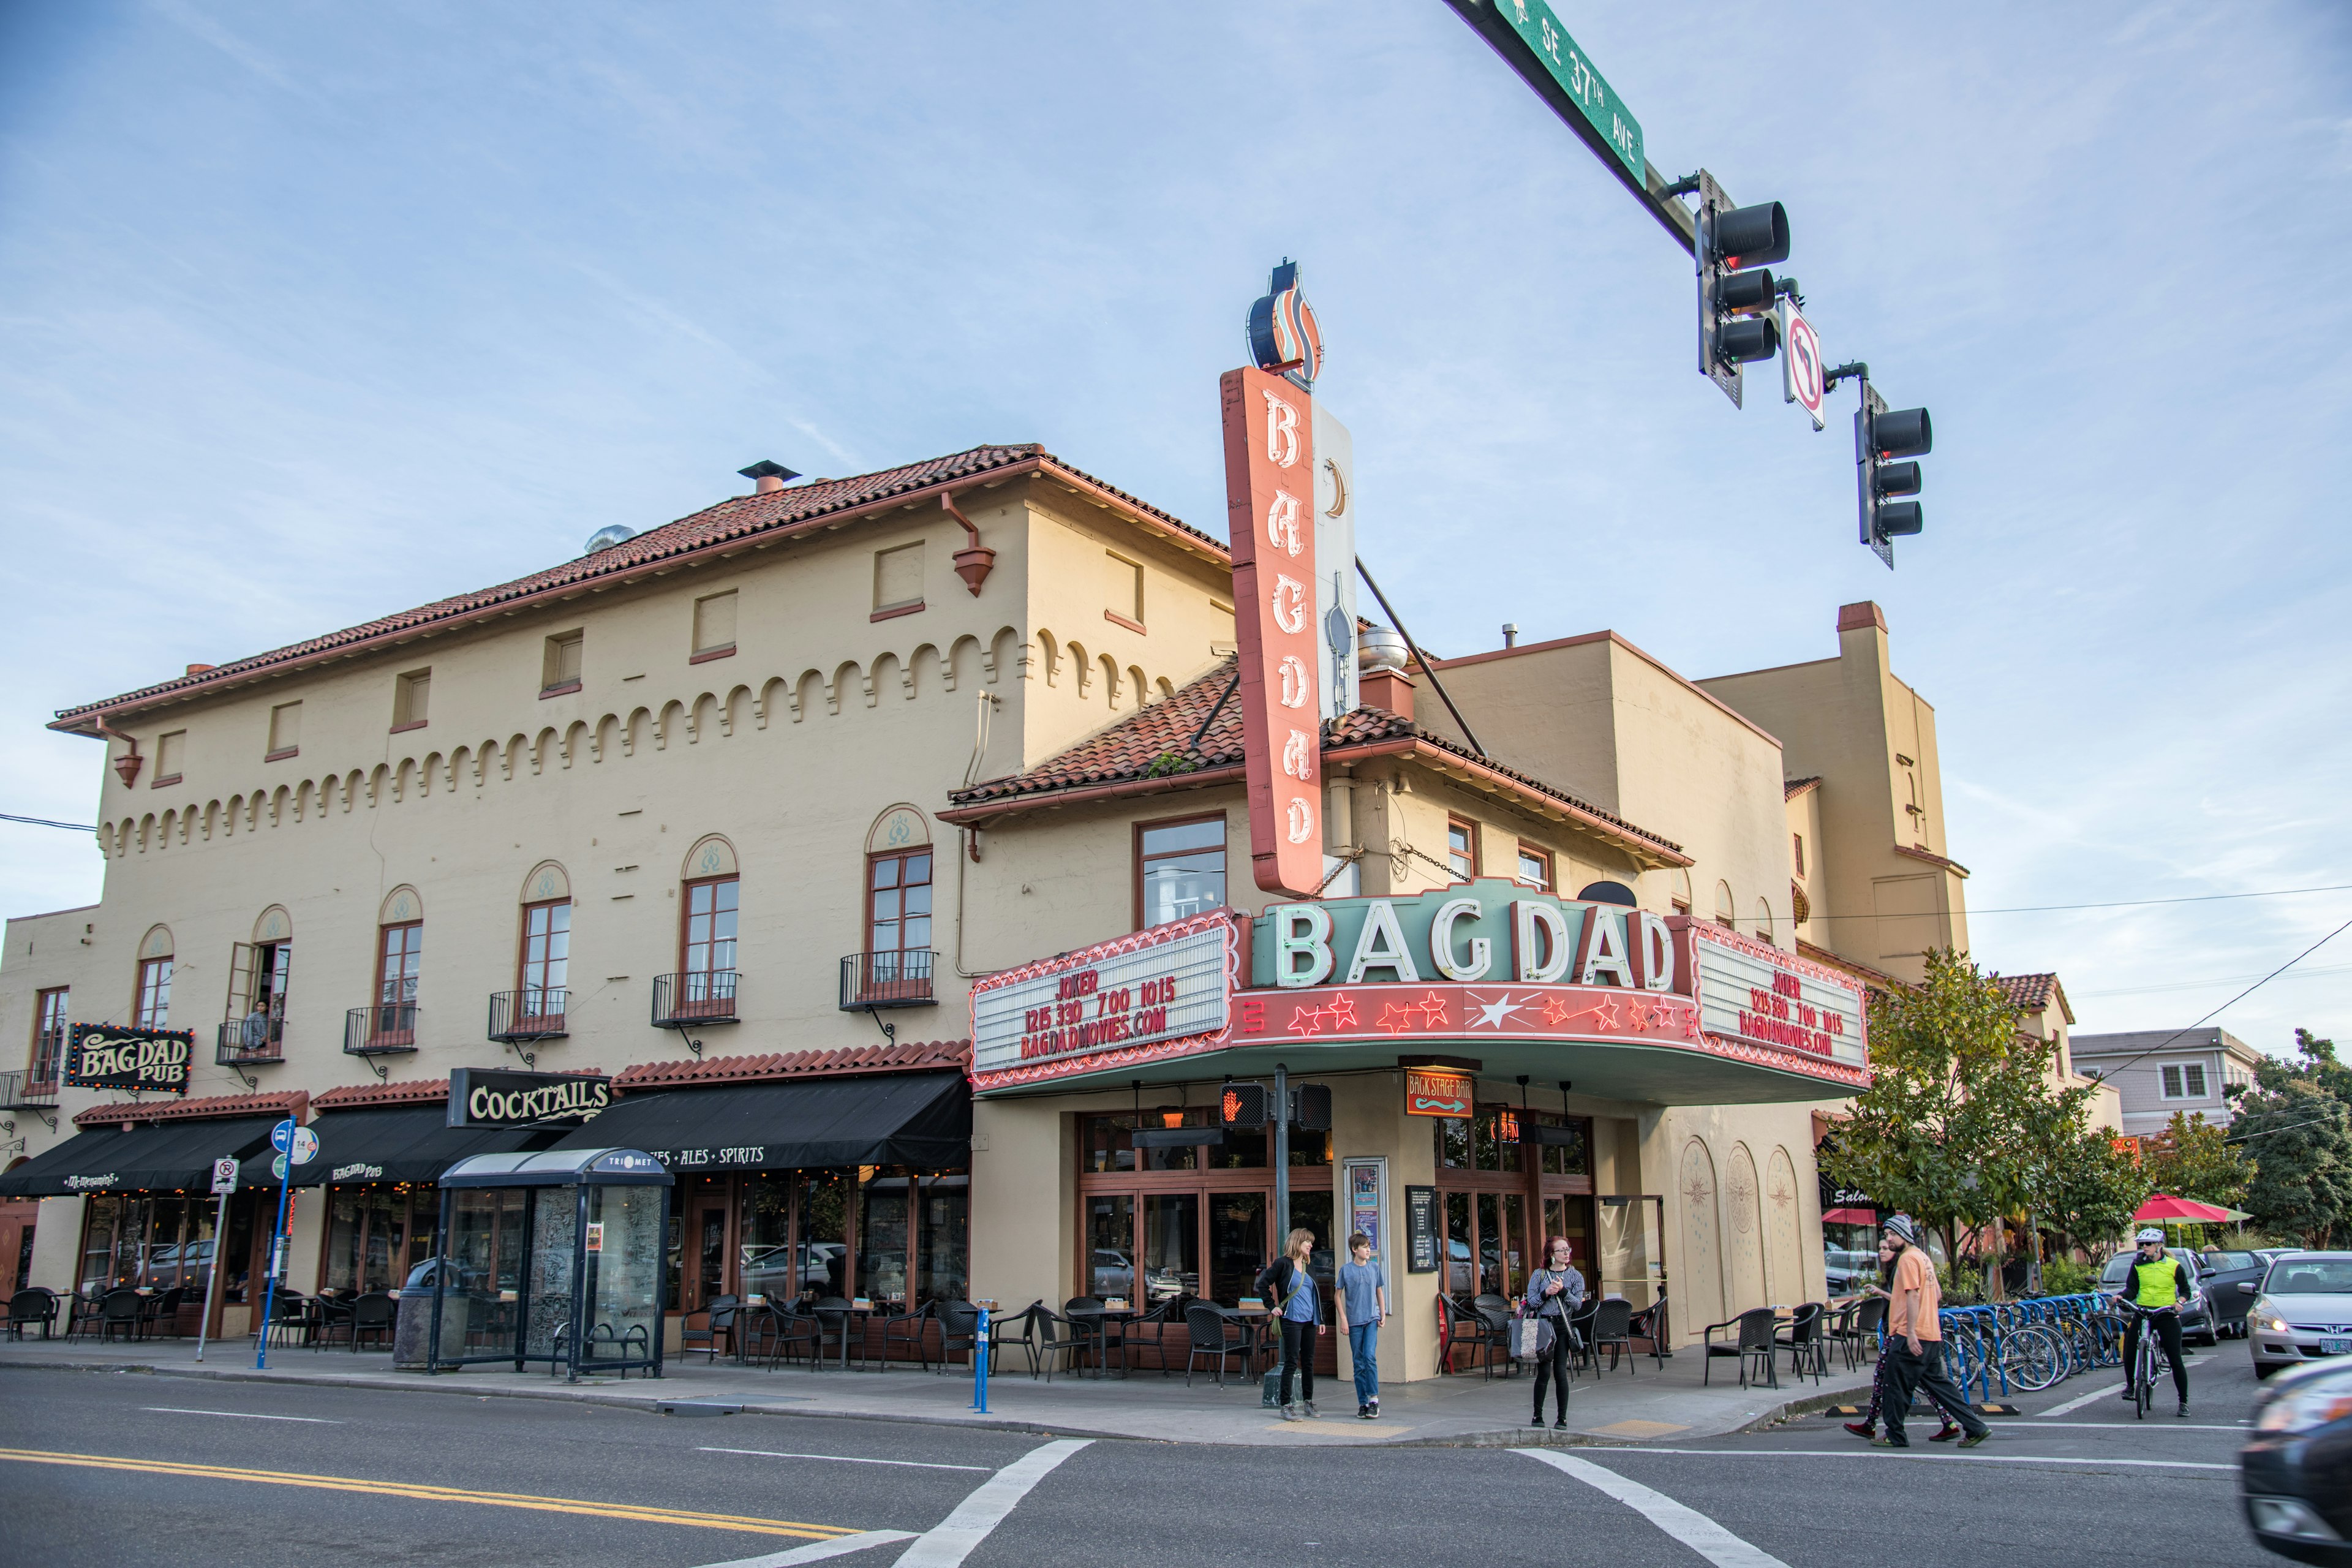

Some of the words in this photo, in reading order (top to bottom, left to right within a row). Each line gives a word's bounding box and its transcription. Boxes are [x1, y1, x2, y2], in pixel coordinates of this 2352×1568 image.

[1542, 17, 1561, 67] SE
[1569, 50, 1604, 108] 37TH
[1613, 111, 1635, 164] AVE
[1262, 388, 1314, 845] BAGDAD
[1275, 897, 1675, 992] BAGDAD
[1055, 969, 1098, 1001] JOKER
[1771, 969, 1802, 1001] JOKER
[1056, 1000, 1082, 1027] 330
[1771, 995, 1790, 1022] 330
[1020, 1006, 1167, 1060] BAGDADMOVIES.COM
[1739, 1009, 1833, 1057] BAGDADMOVIES.COM
[80, 1038, 188, 1078] BAGDAD
[138, 1064, 186, 1083] PUB
[469, 1081, 609, 1121] COCKTAILS
[1409, 1074, 1431, 1096] BACK
[1431, 1077, 1455, 1098] STAGE
[1456, 1079, 1471, 1099] BAR
[333, 1163, 366, 1181] BAGDAD
[364, 1165, 383, 1178] PUB
[680, 1148, 709, 1166] ALES
[718, 1146, 765, 1165] SPIRITS
